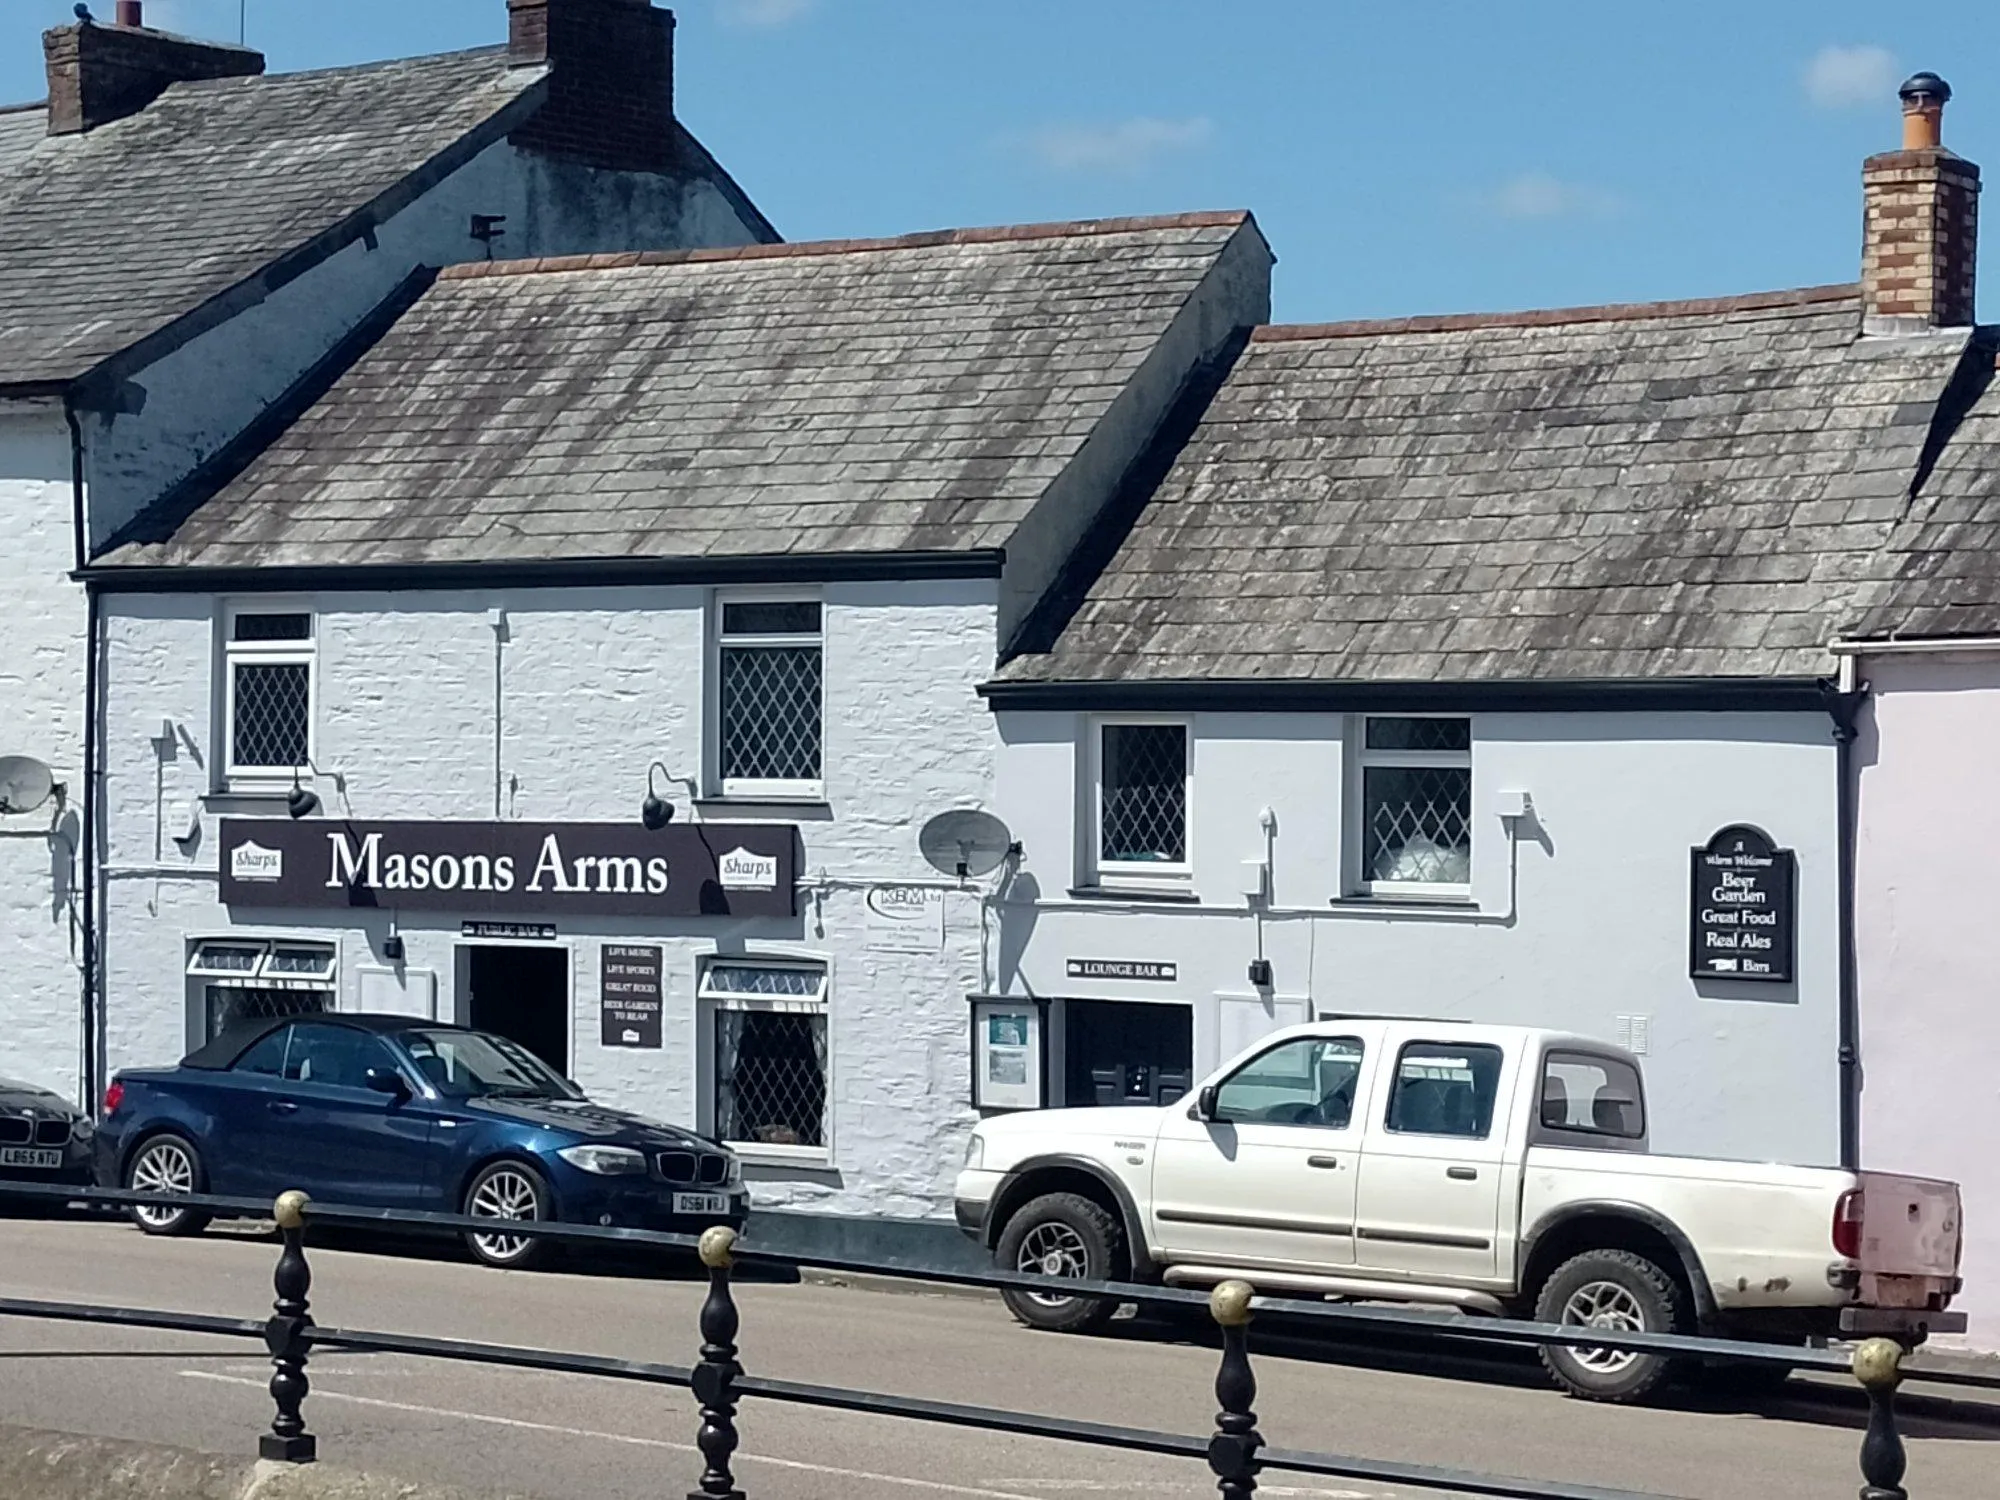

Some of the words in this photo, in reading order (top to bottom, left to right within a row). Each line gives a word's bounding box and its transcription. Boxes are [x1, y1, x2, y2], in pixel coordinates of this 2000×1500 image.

[325, 832, 515, 892] Masons
[525, 833, 669, 894] Arms
[1722, 872, 1756, 888] Beer
[1712, 886, 1766, 903] Garden
[1701, 909, 1739, 925] Great
[1742, 910, 1776, 925] Food
[1706, 932, 1738, 948] Real
[1741, 934, 1771, 949] Ales
[1084, 963, 1133, 976] LOUNGE
[1135, 965, 1158, 977] BAR
[1743, 959, 1770, 973] Bars
